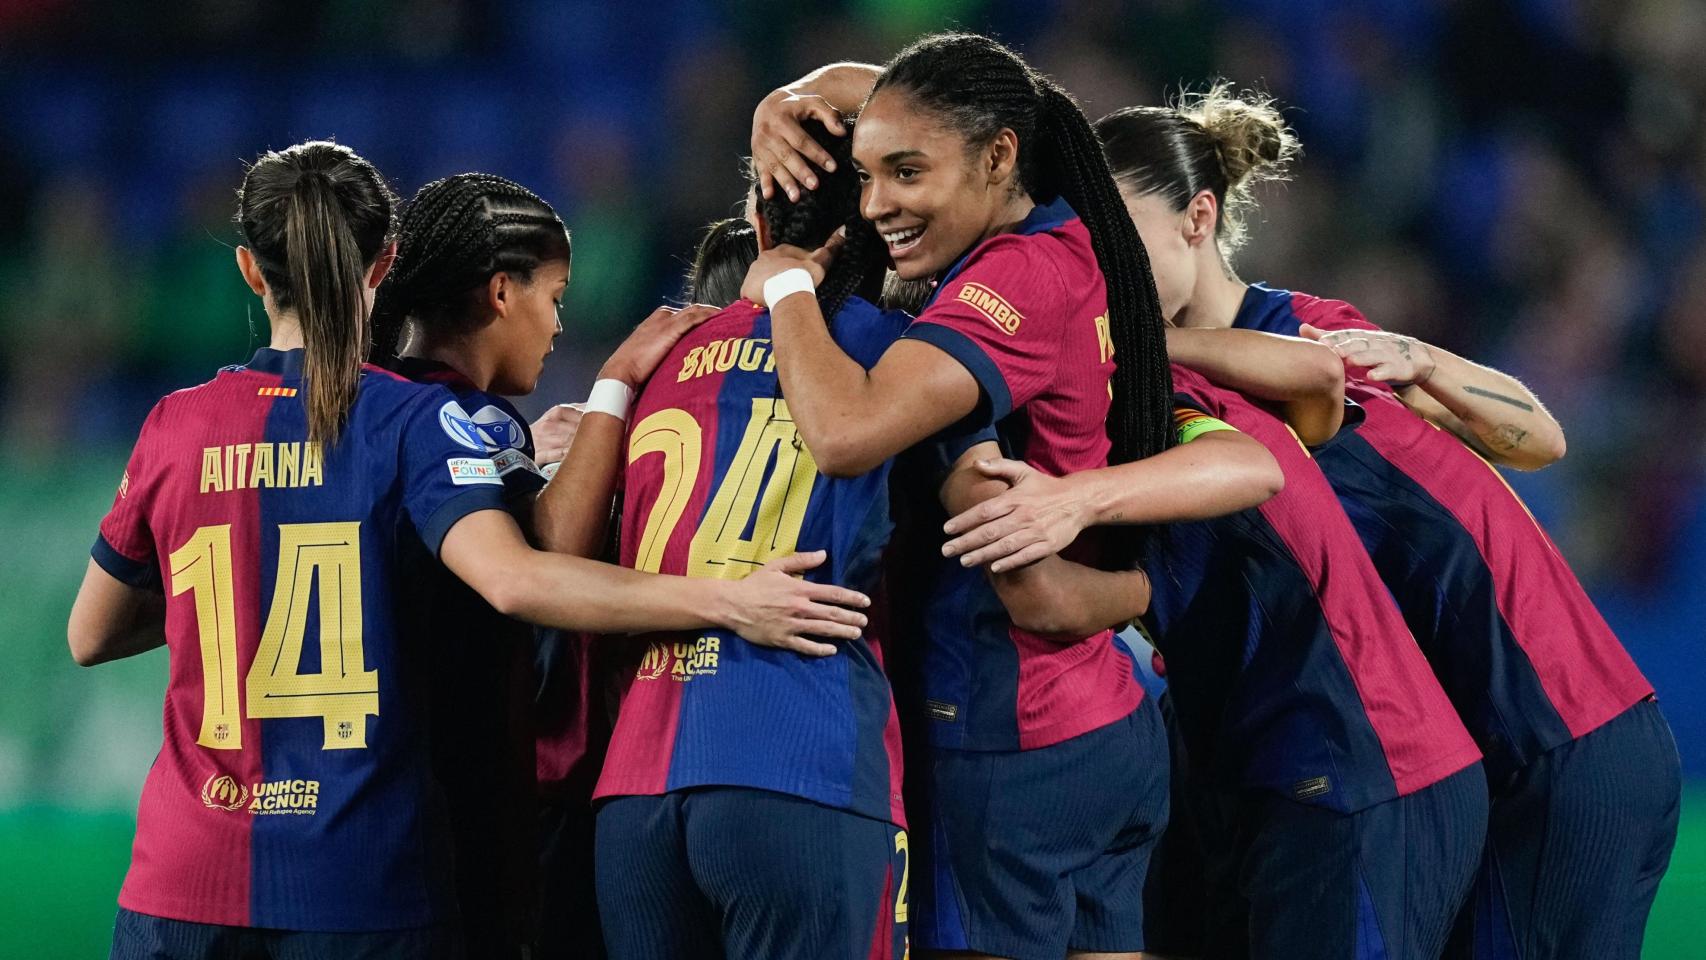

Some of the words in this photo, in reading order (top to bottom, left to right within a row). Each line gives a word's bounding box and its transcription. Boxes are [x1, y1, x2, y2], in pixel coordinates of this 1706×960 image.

[958, 285, 1020, 332] BIMBO
[200, 442, 323, 493] AITANA
[629, 398, 819, 581] 24
[169, 522, 379, 750] 14
[248, 794, 318, 810] ACNUR
[252, 780, 319, 796] UNHCR
[293, 808, 316, 816] Agency
